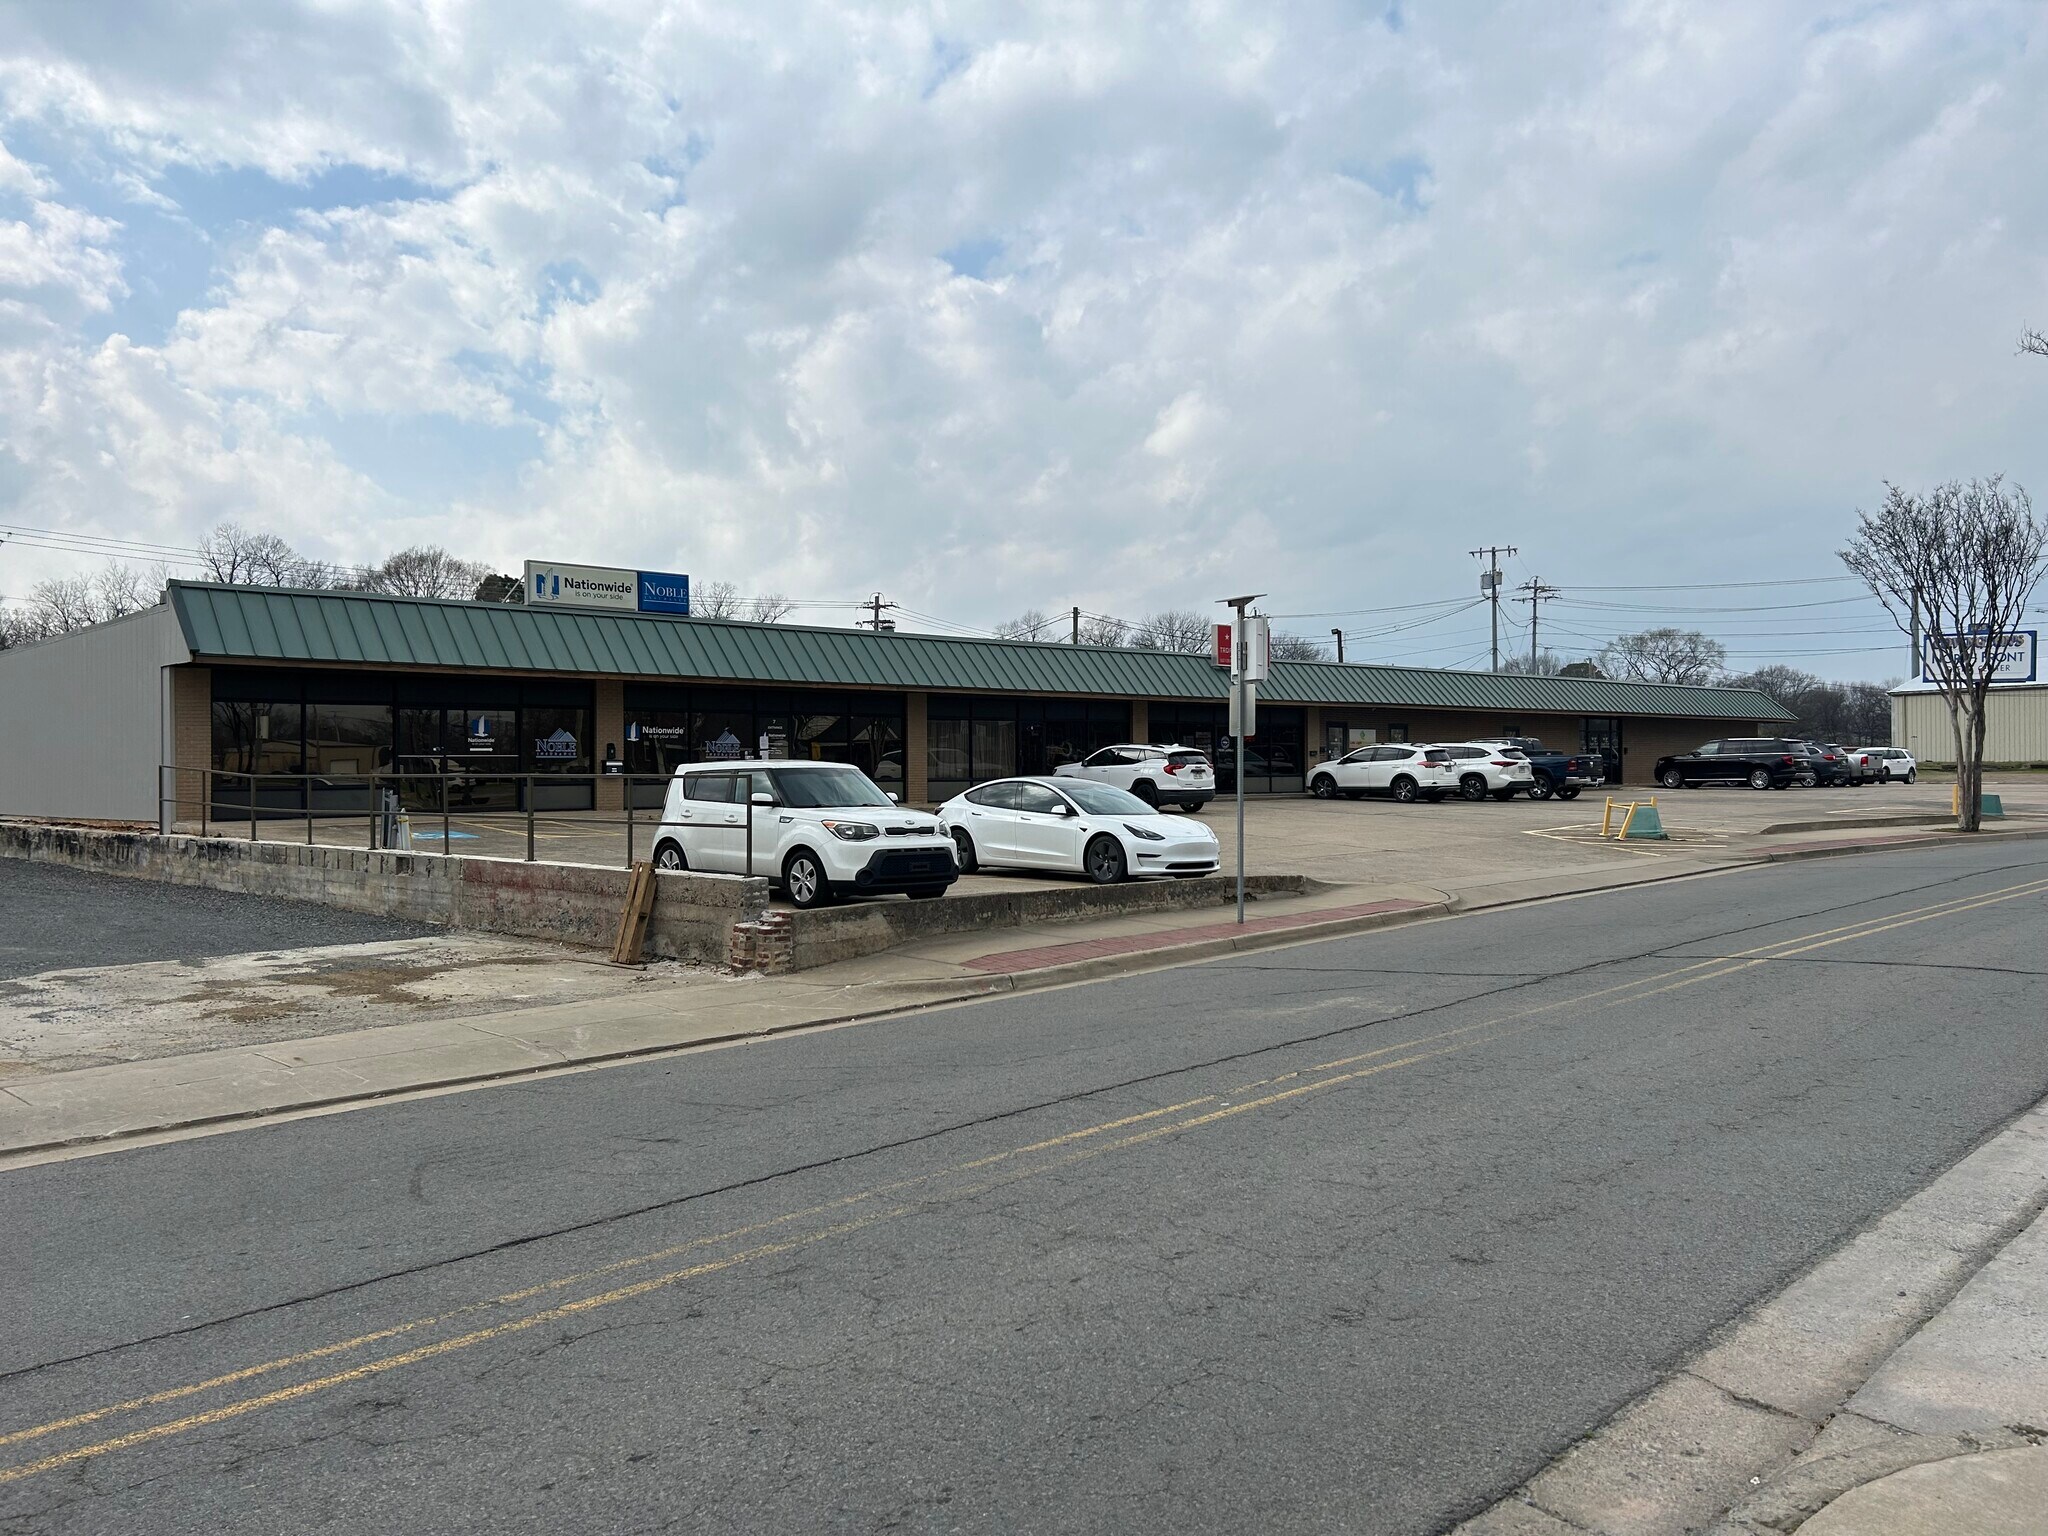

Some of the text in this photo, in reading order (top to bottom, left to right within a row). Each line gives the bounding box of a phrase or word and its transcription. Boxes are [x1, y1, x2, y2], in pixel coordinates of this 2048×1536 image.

[564, 577, 632, 594] Nationwide
[593, 592, 609, 600] your
[609, 593, 624, 601] side
[642, 726, 684, 734] Nationwide
